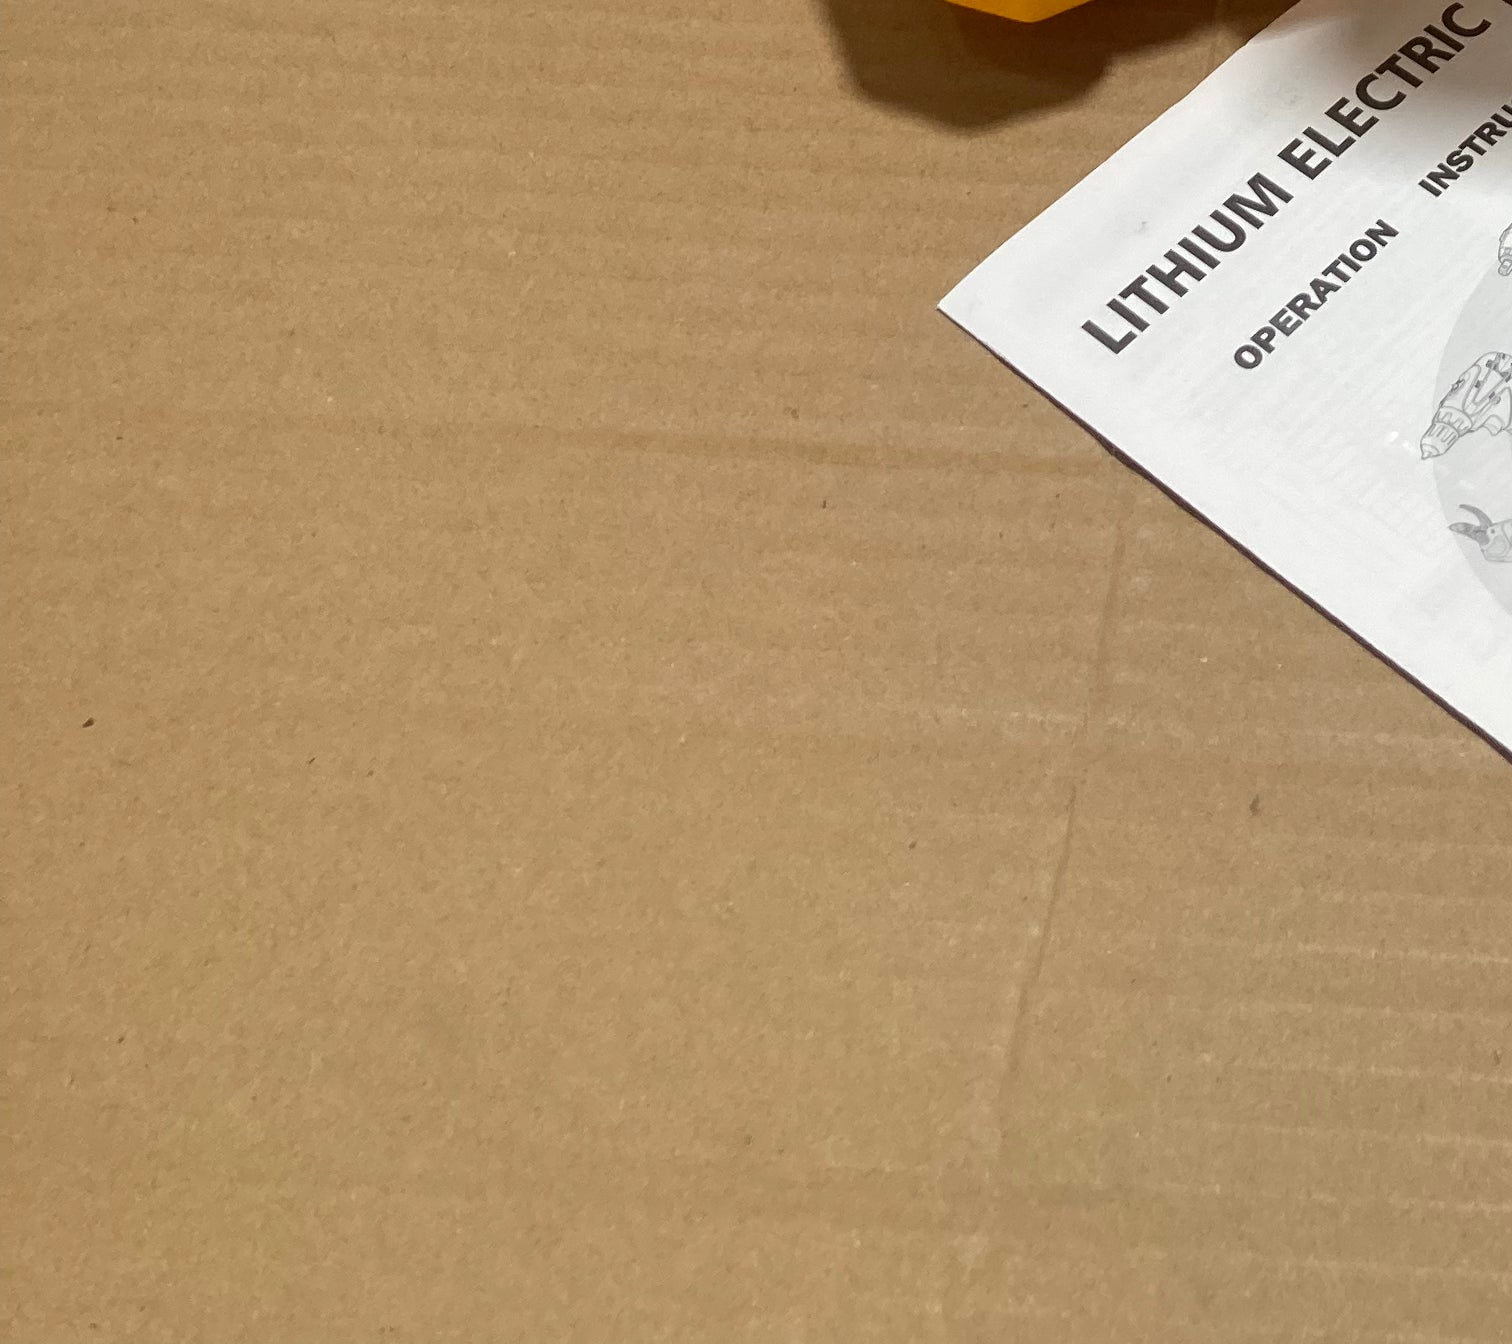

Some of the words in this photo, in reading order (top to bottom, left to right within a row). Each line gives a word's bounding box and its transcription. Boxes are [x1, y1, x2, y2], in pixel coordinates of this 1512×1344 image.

[1081, 172, 1294, 355] LITHIUM
[1277, 1, 1492, 181] ELECTRIC
[1233, 218, 1400, 370] OPERATION
